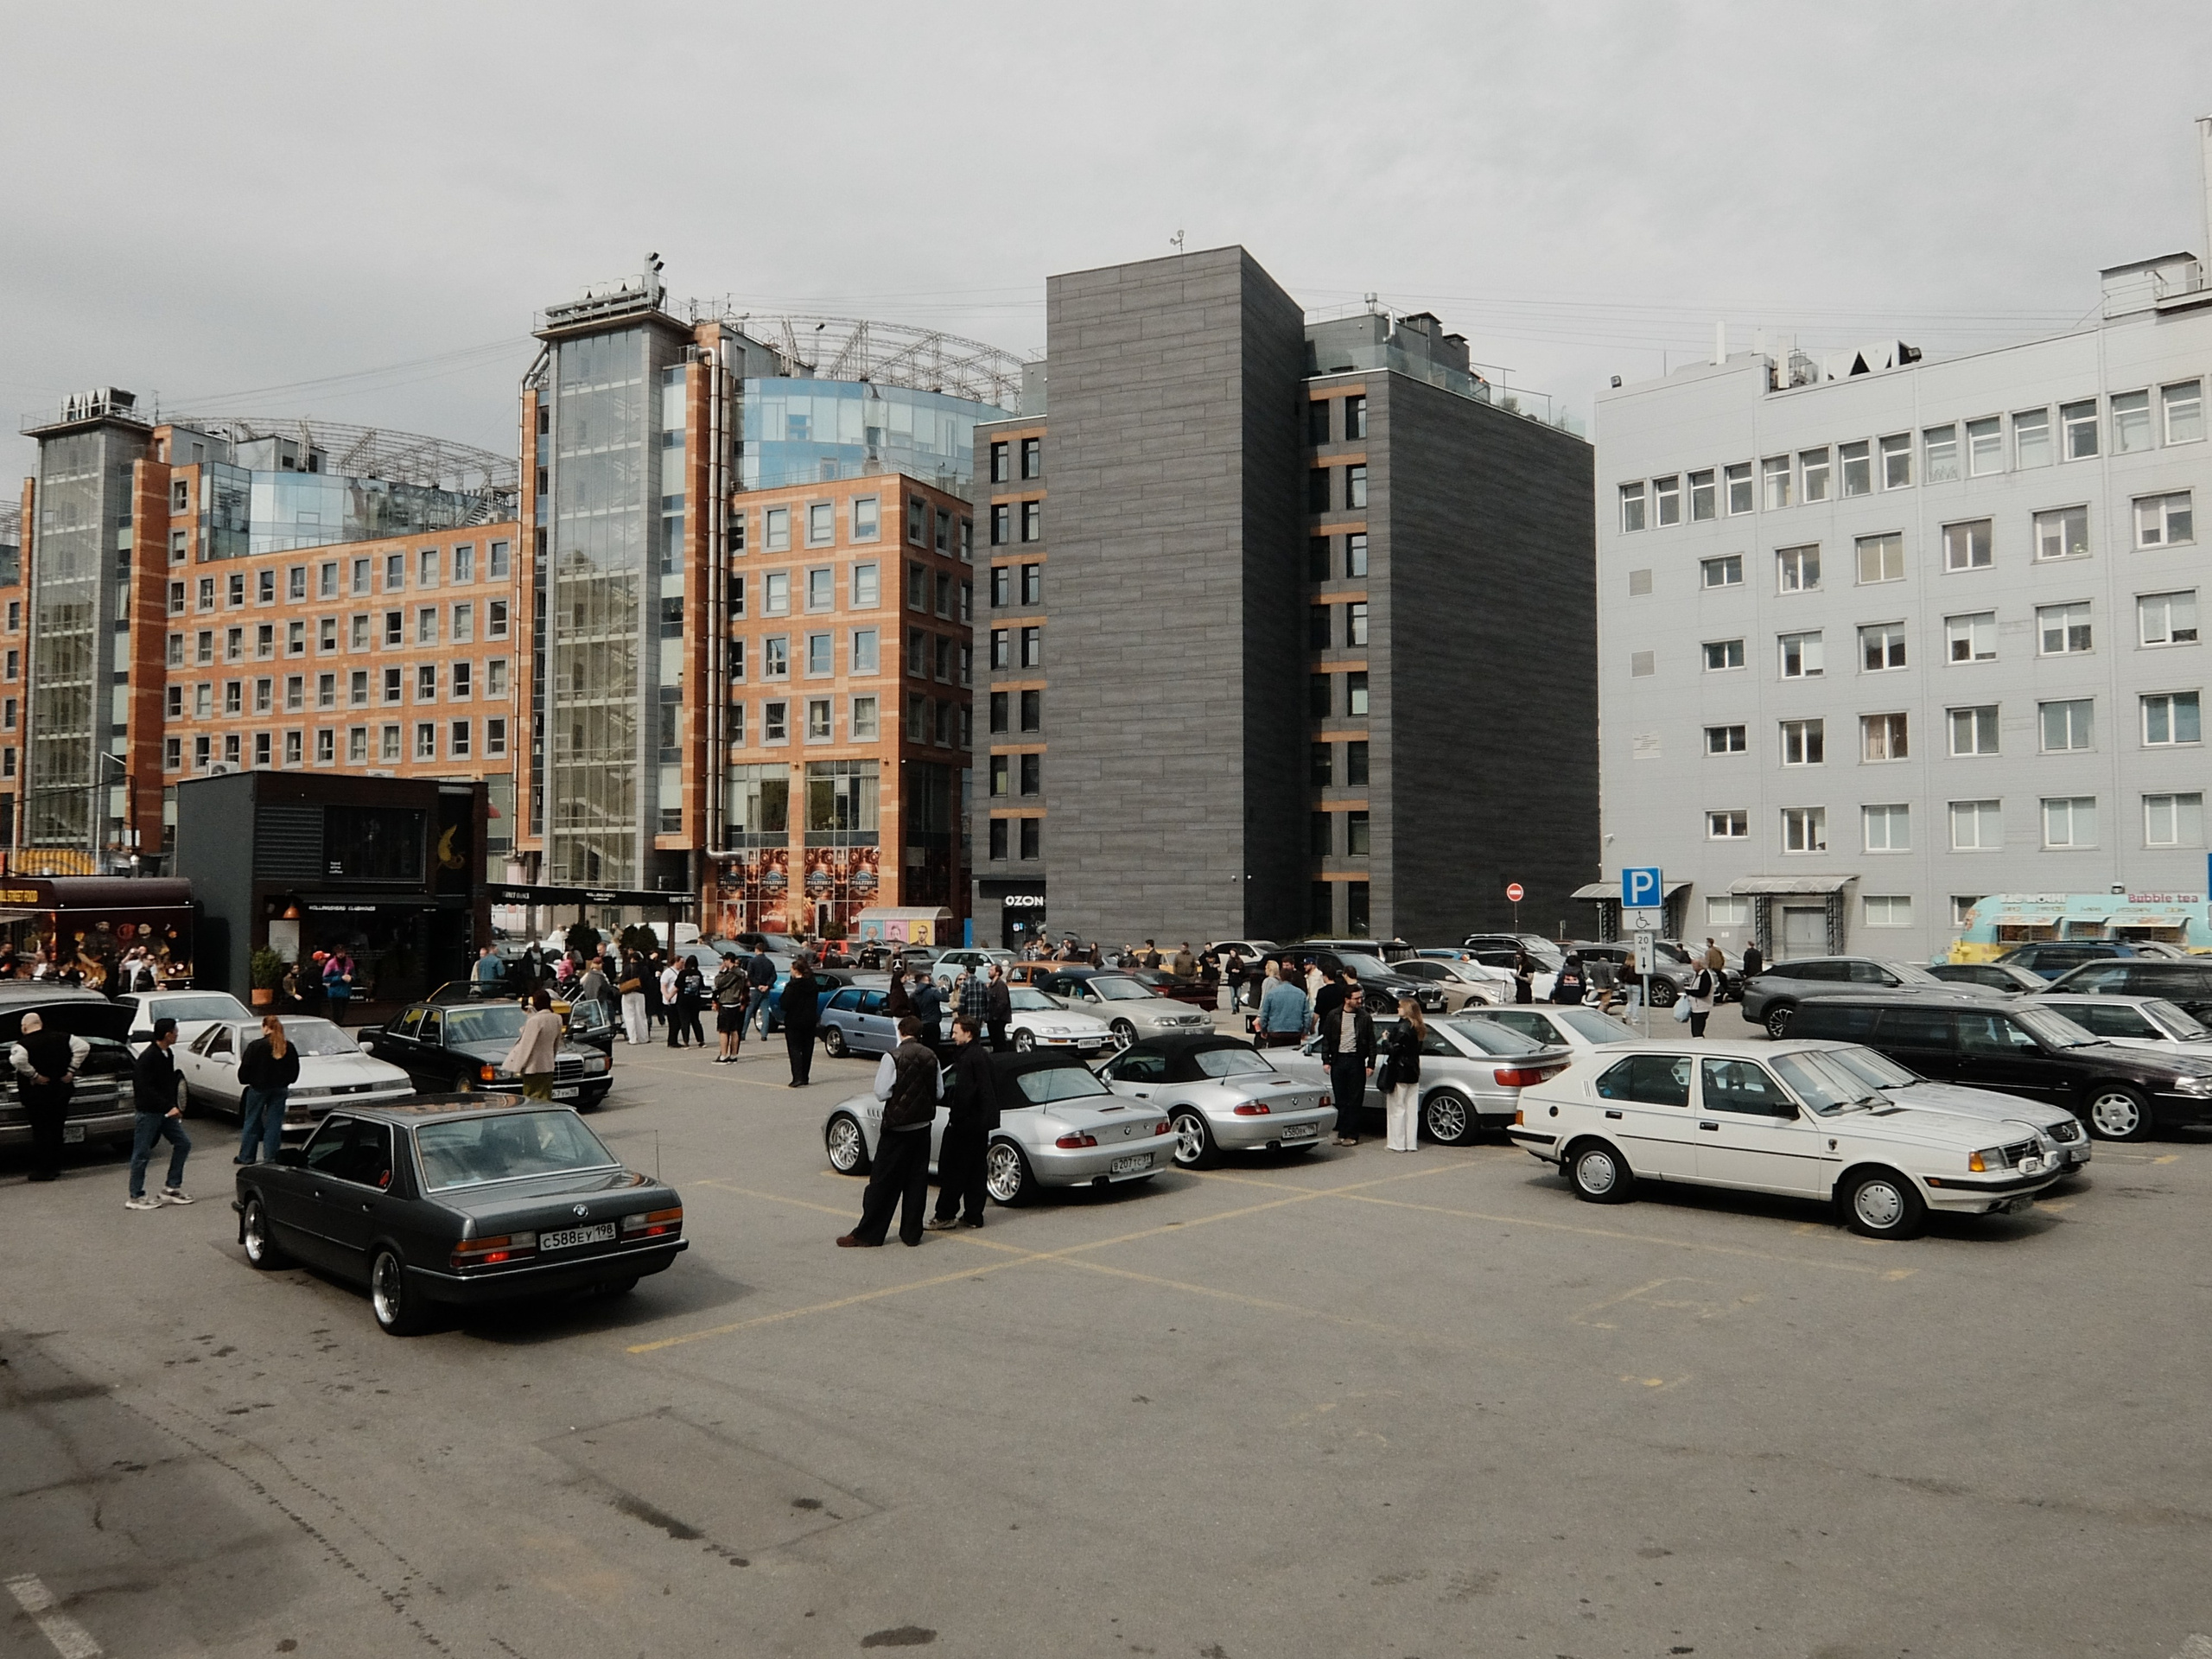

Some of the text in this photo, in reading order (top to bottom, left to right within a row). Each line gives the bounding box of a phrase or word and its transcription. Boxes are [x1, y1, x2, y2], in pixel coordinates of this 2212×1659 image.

[1631, 871, 1653, 904] P
[24, 890, 38, 902] FOOD
[1005, 895, 1044, 906] OZON
[2128, 893, 2199, 903] Bubble tea
[1637, 936, 1649, 944] 20
[594, 1224, 613, 1236] 198
